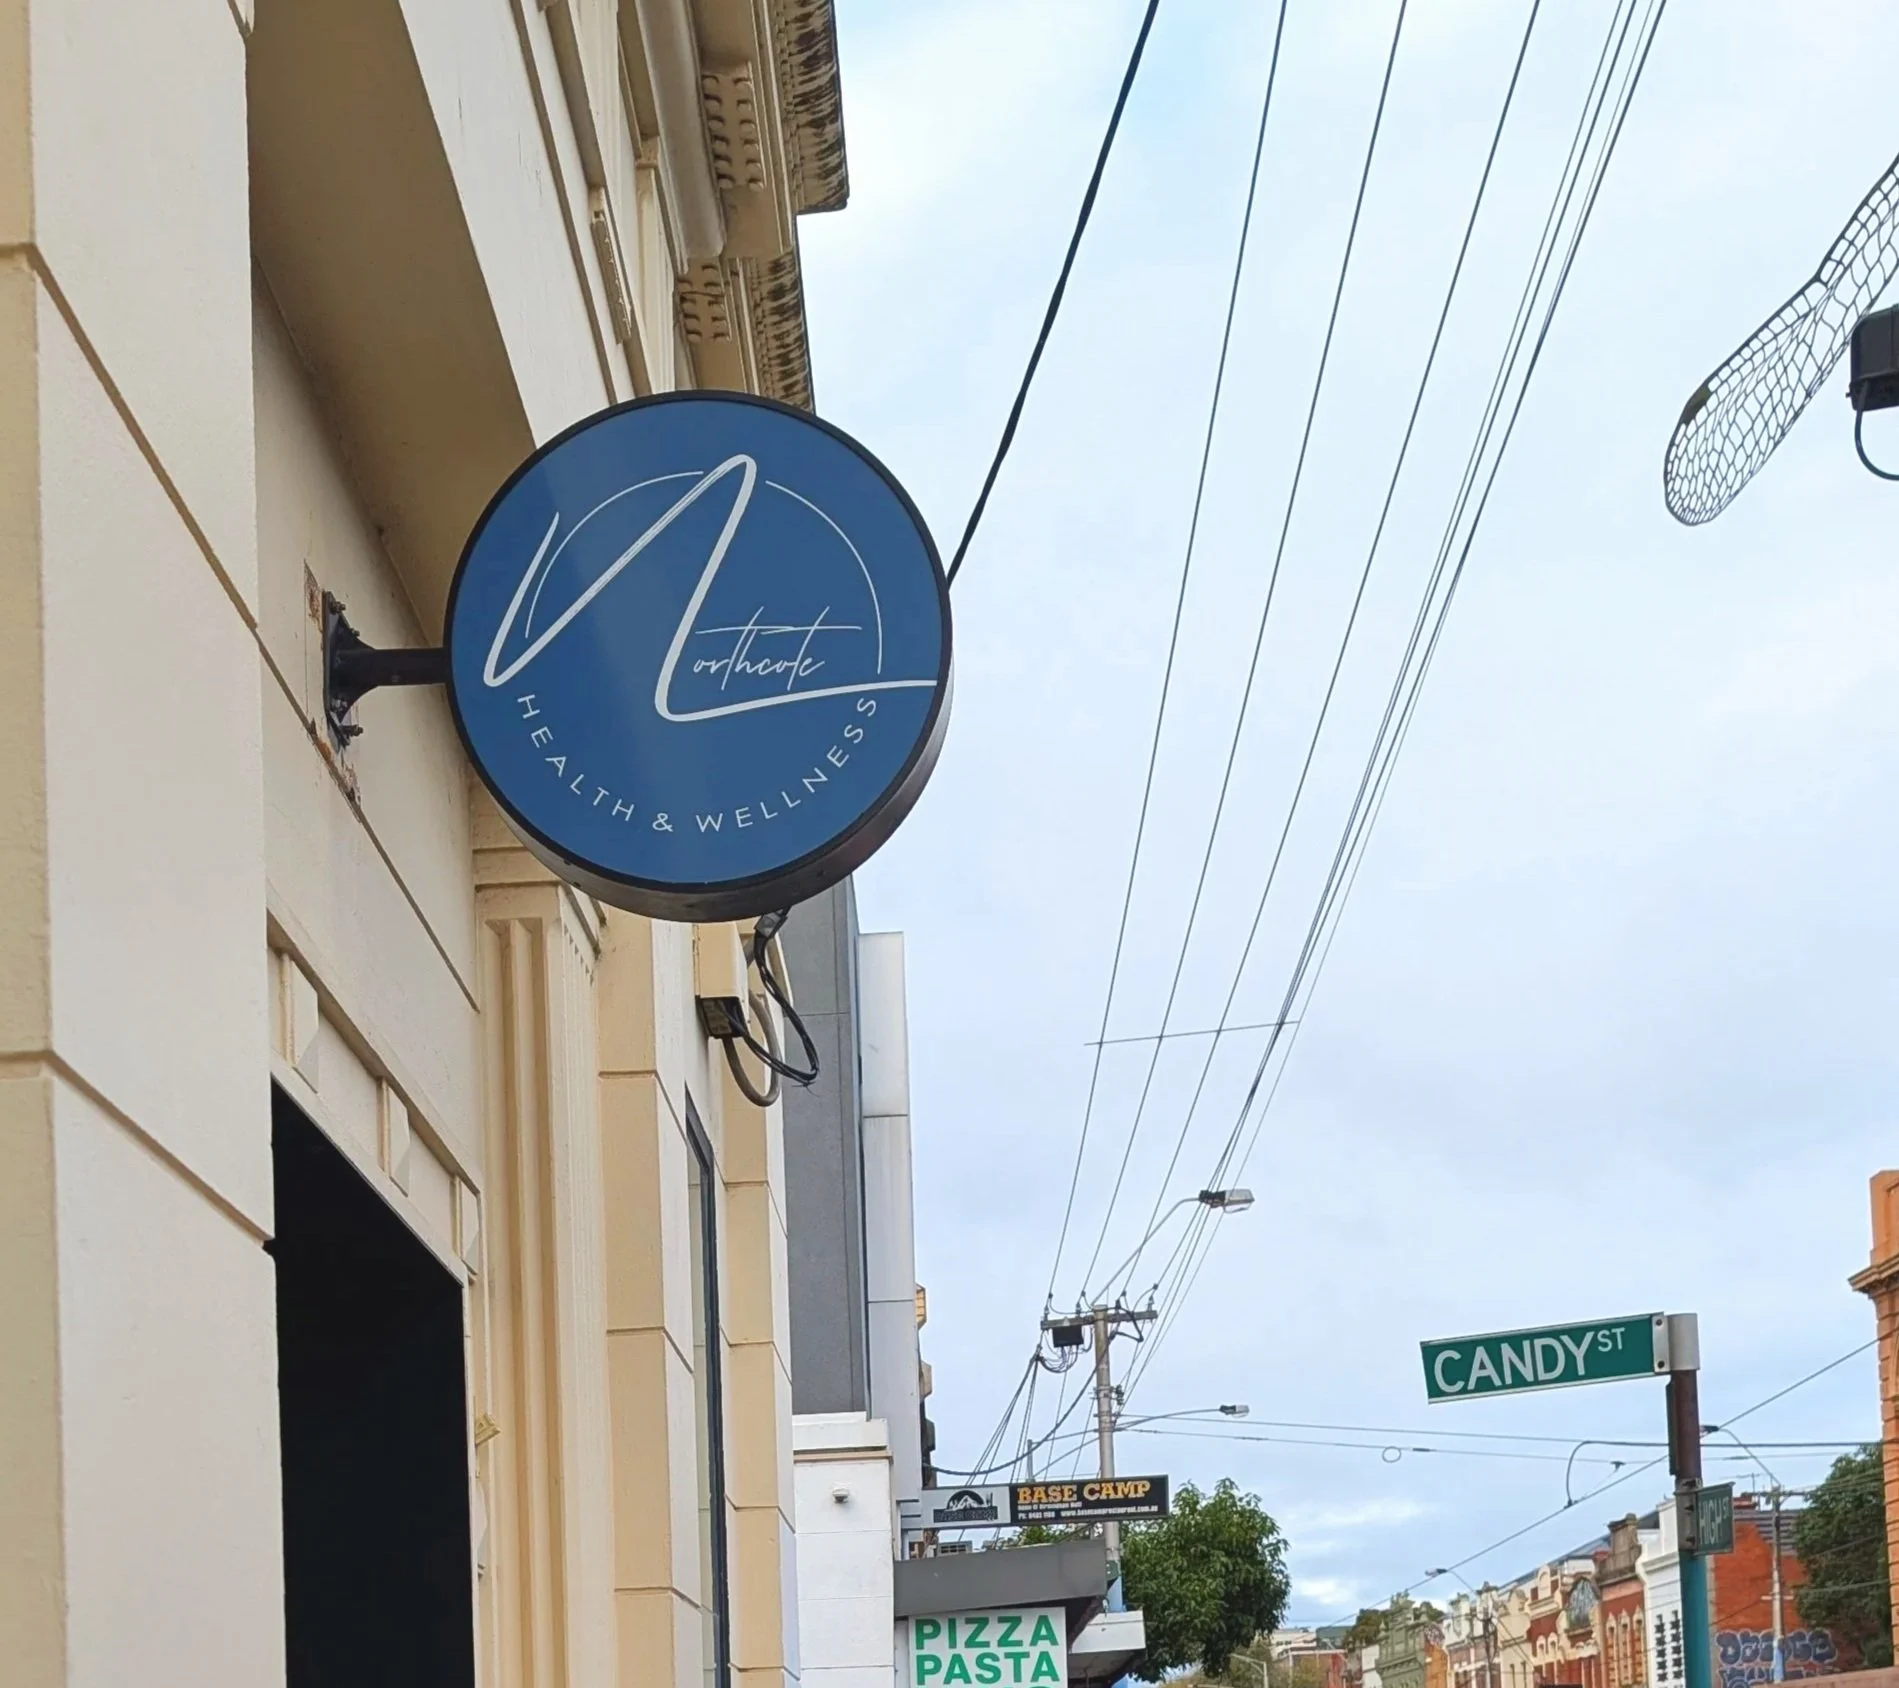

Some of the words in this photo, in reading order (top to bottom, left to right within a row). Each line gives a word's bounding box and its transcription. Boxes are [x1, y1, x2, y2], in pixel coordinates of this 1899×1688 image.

[517, 694, 635, 822] HEALTH
[652, 812, 674, 832] &
[696, 697, 877, 833] WELLNESS
[1433, 1331, 1594, 1393] CANDY
[1597, 1327, 1625, 1352] ST
[1017, 1484, 1077, 1504] BASE
[1083, 1480, 1151, 1500] CAMP
[1698, 1499, 1721, 1545] HIGH
[915, 1615, 1059, 1650] PIZZA
[916, 1651, 1060, 1685] PASTA
